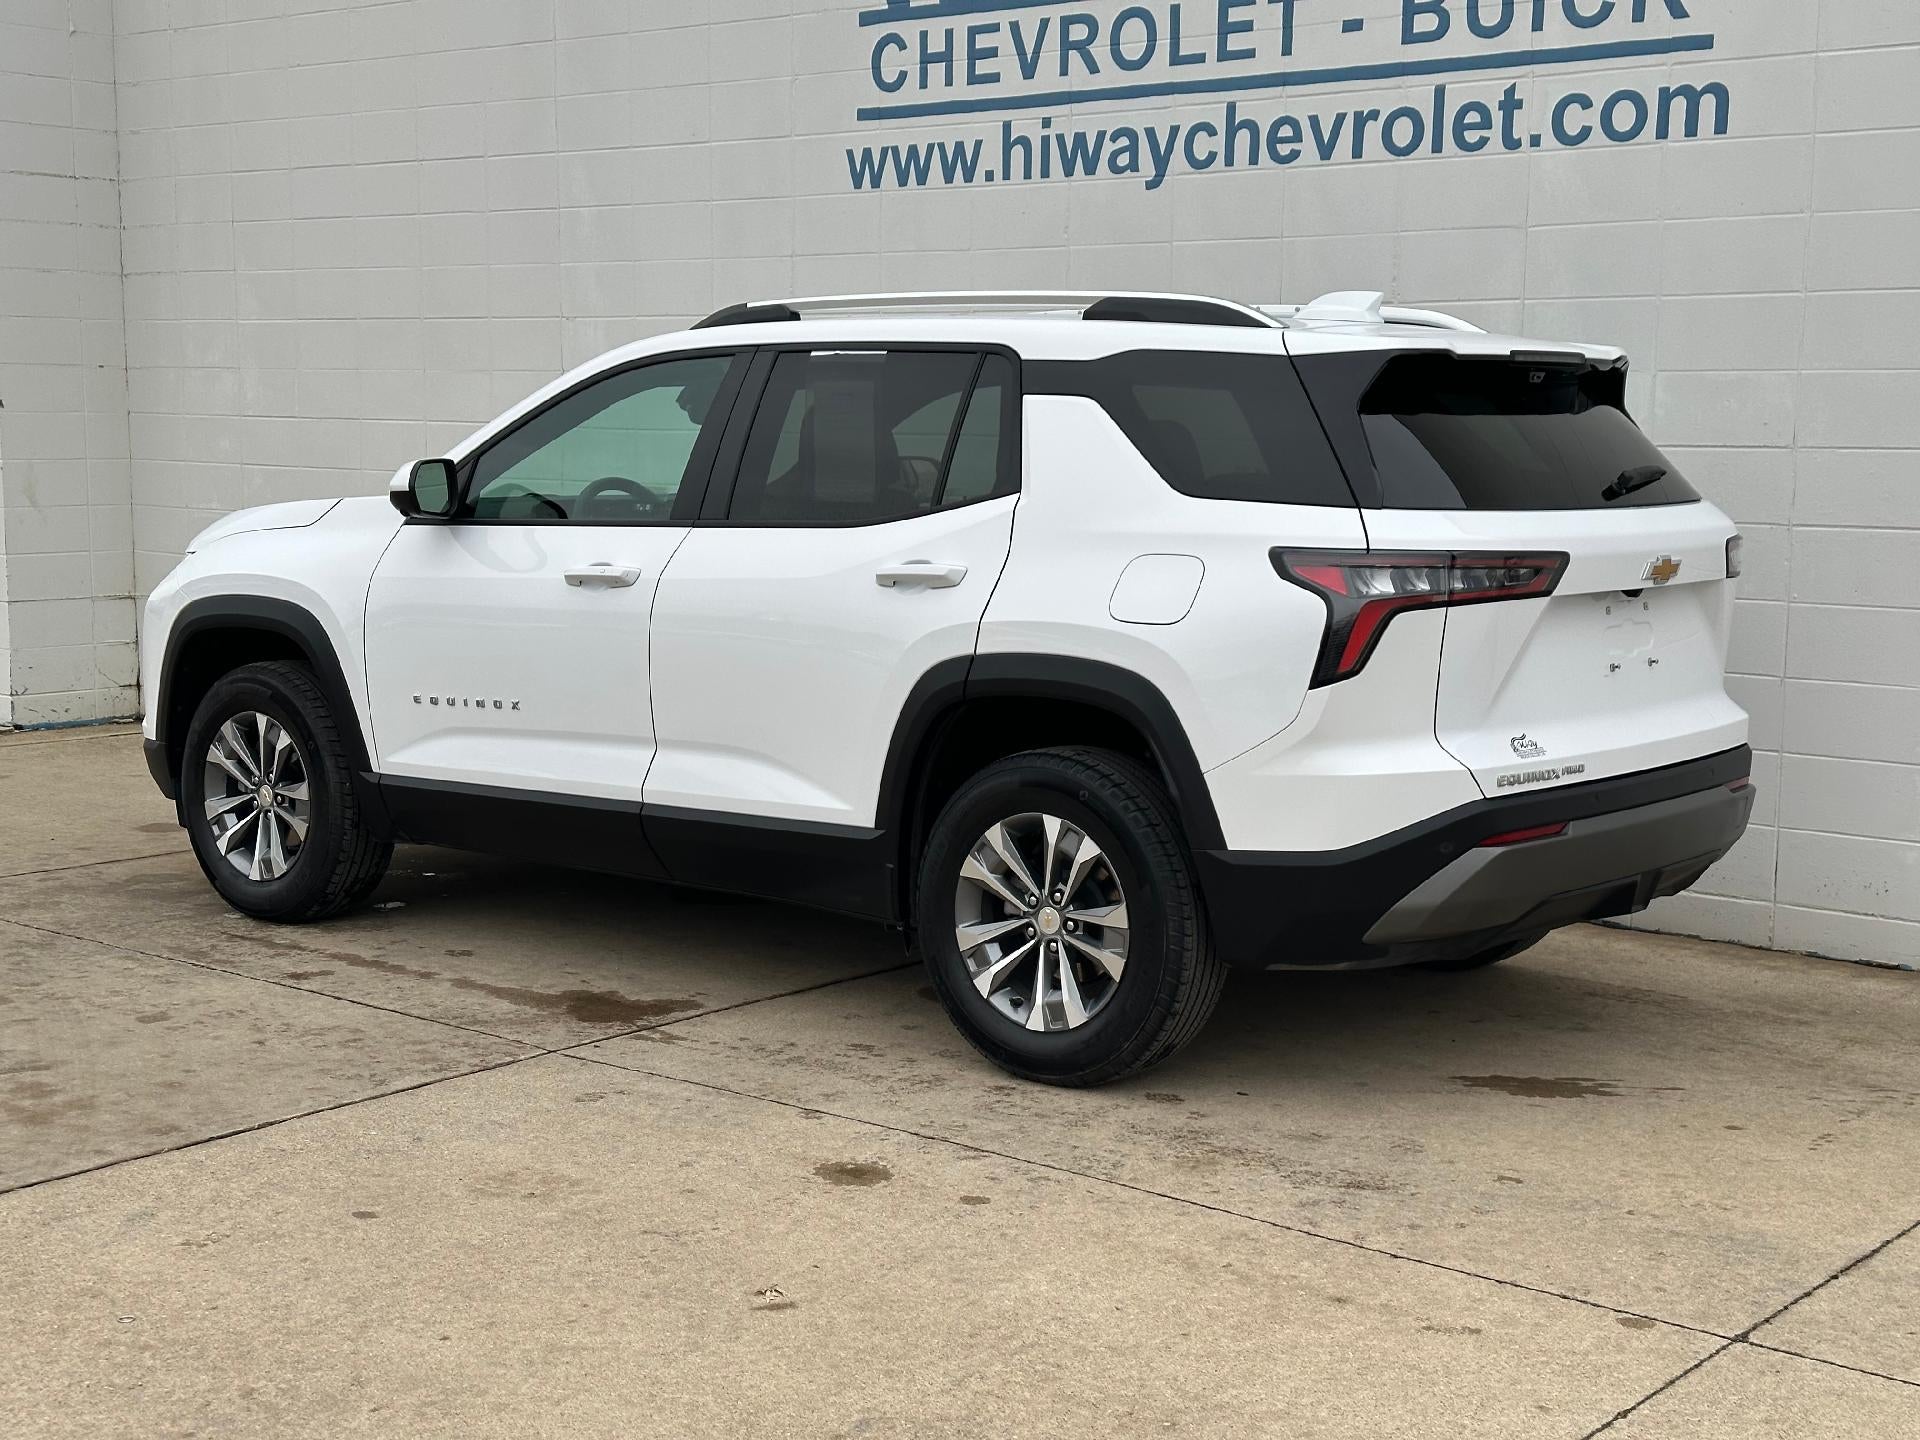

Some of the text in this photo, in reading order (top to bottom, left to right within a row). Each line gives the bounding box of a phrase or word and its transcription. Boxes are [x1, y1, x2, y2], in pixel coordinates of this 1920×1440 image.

[870, 0, 1302, 93] CHEVROLET
[845, 81, 1730, 191] www.hiwaychevrolet.com
[412, 693, 521, 711] EQUINOX
[1497, 768, 1560, 787] EQUINOX
